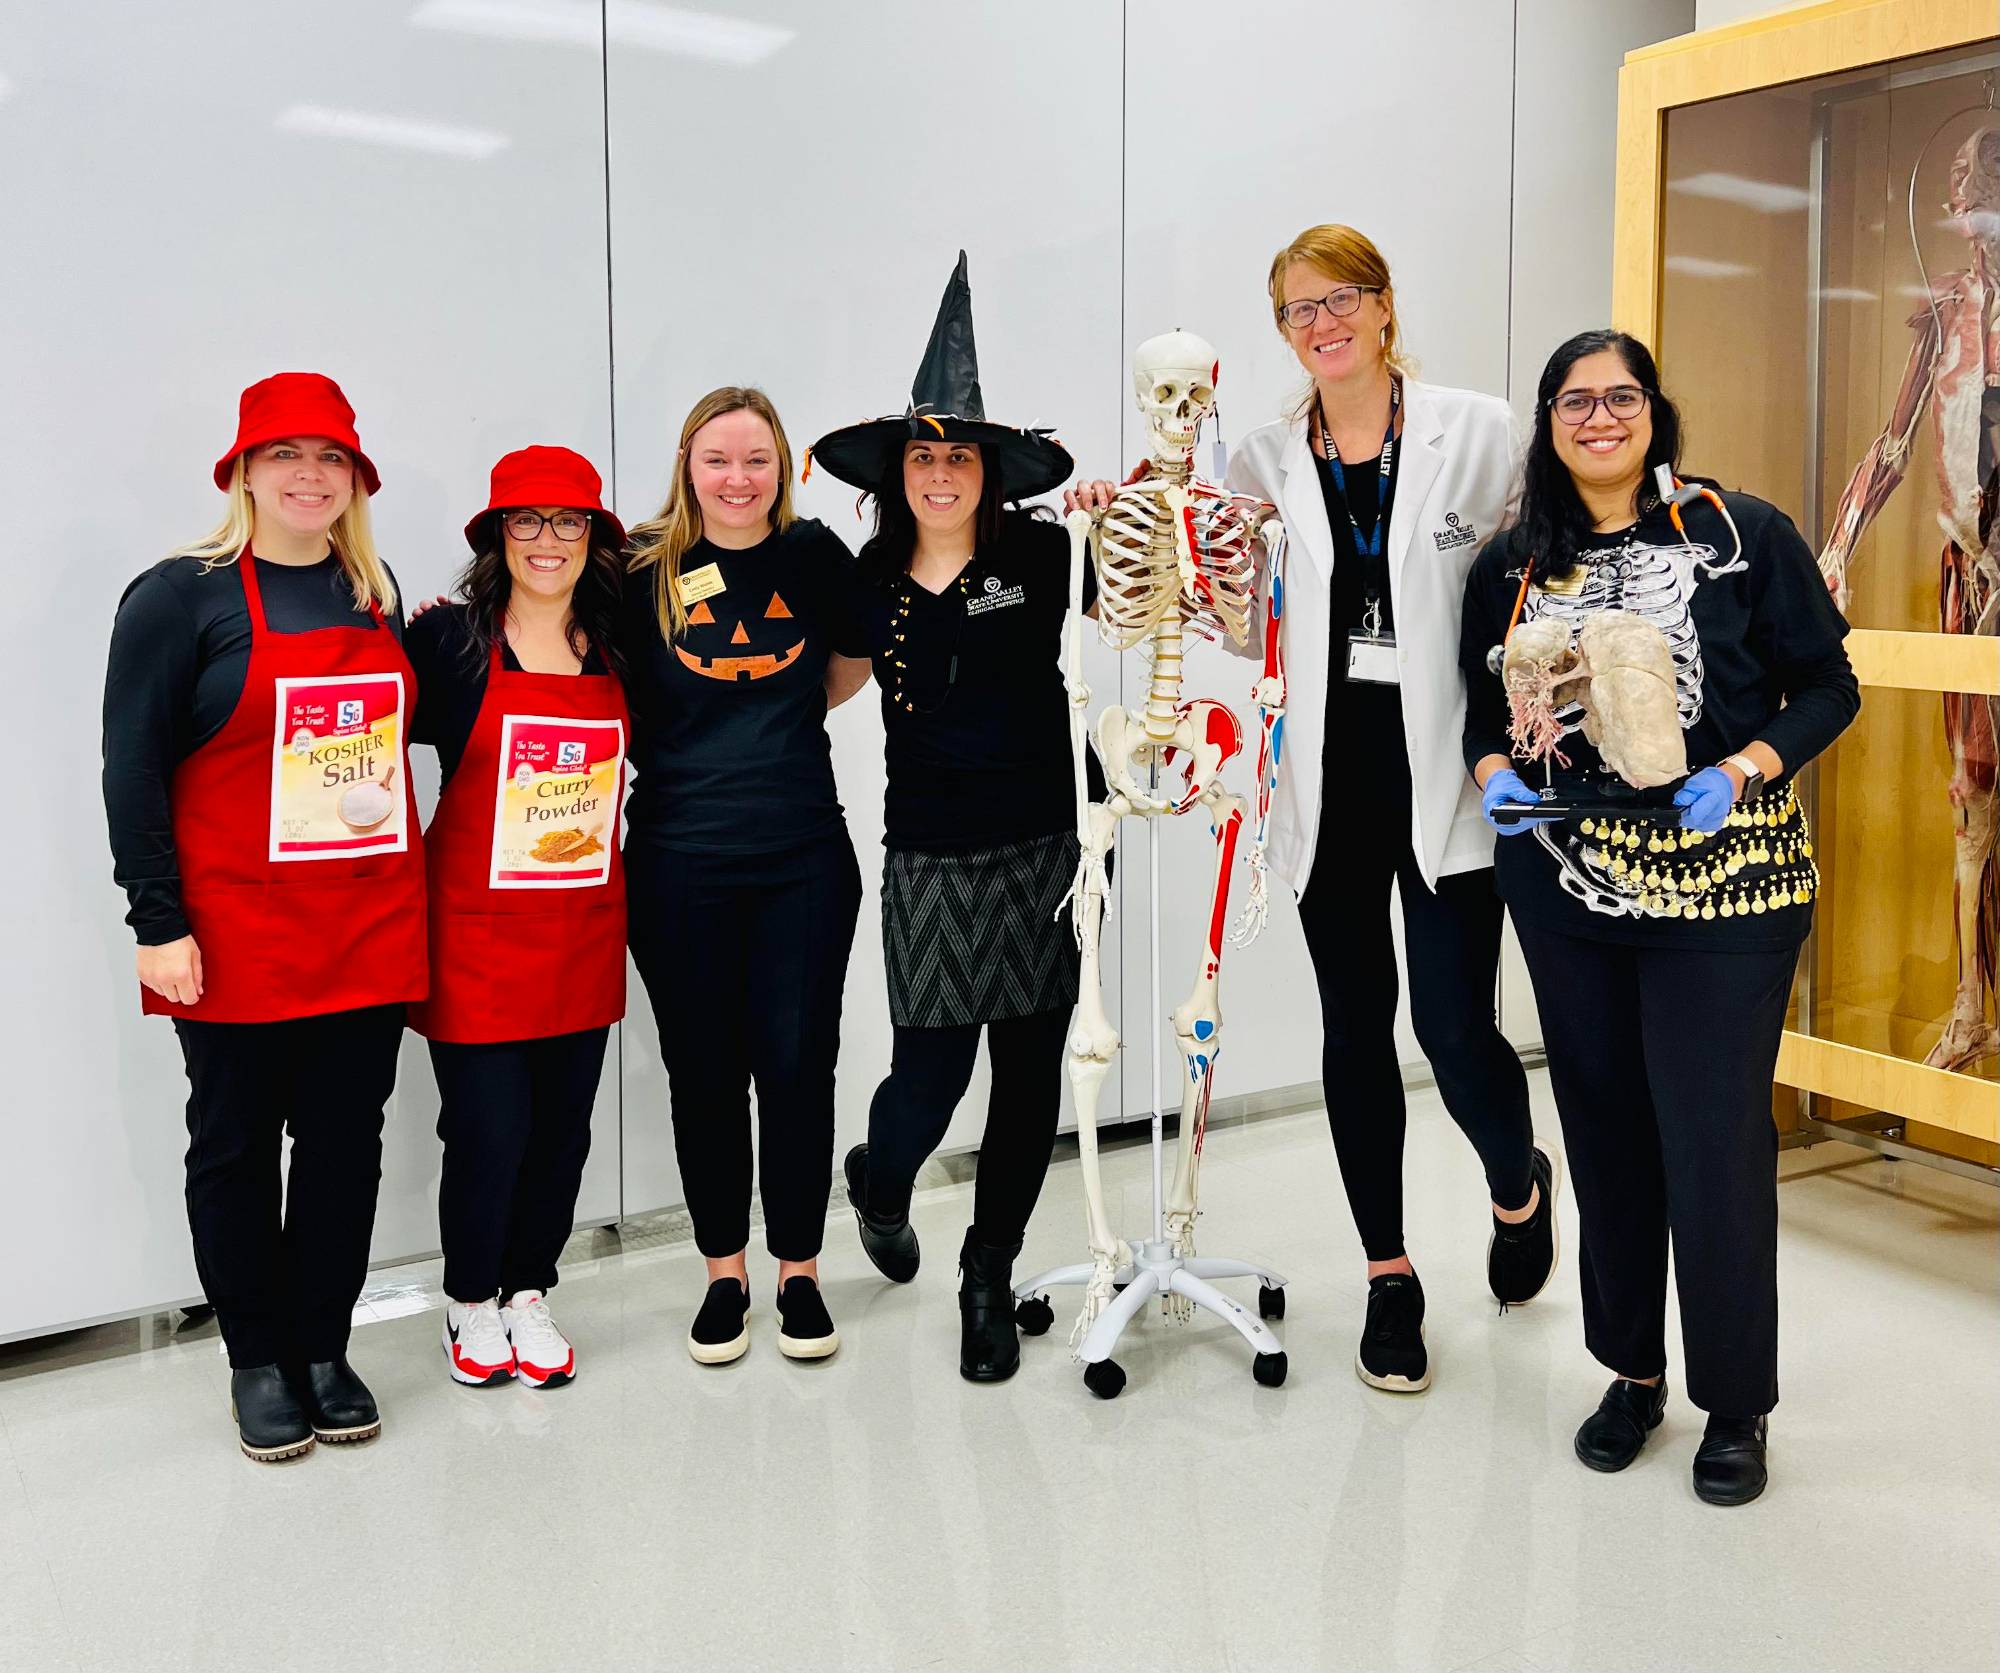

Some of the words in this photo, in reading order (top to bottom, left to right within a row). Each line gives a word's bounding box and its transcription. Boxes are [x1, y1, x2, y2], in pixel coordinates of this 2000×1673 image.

[1380, 441, 1392, 476] VALLEY
[967, 594, 996, 605] GRAND
[996, 585, 1022, 596] VALLEY
[308, 734, 385, 766] KOSHER
[323, 755, 376, 787] Salt
[537, 778, 595, 798] Curry
[525, 797, 599, 823] Powder
